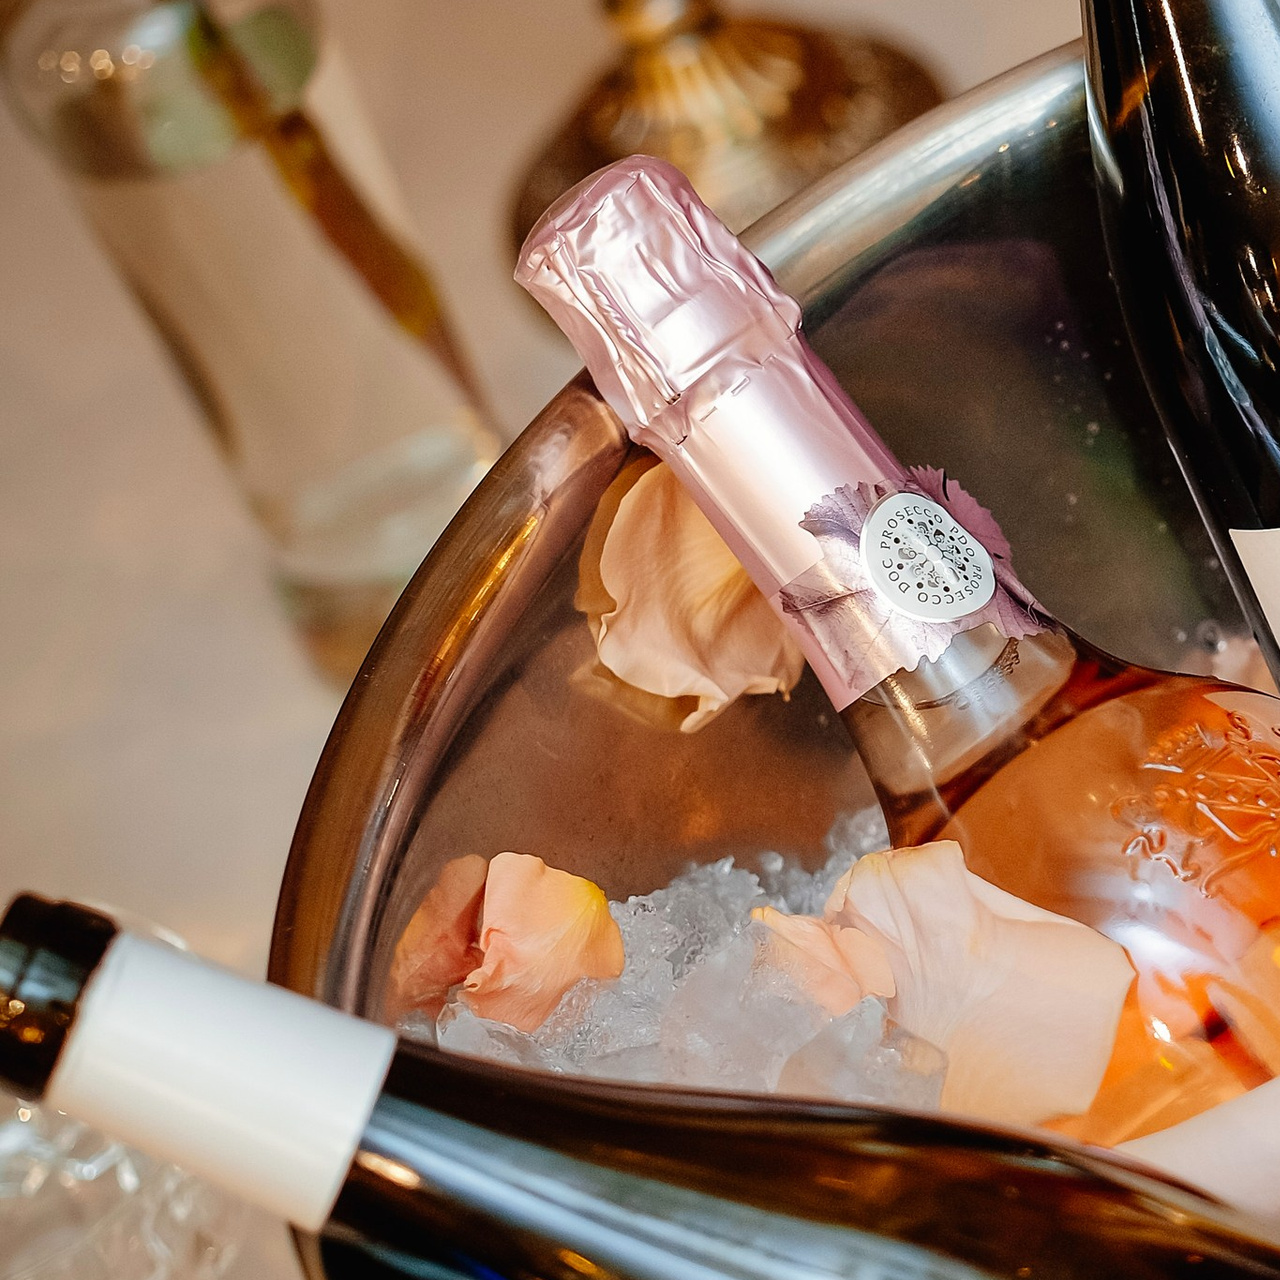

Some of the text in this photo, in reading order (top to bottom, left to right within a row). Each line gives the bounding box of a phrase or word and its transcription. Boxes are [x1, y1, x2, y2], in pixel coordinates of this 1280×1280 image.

[880, 505, 982, 605] PROSECCO PDO PROSECCO DOC
